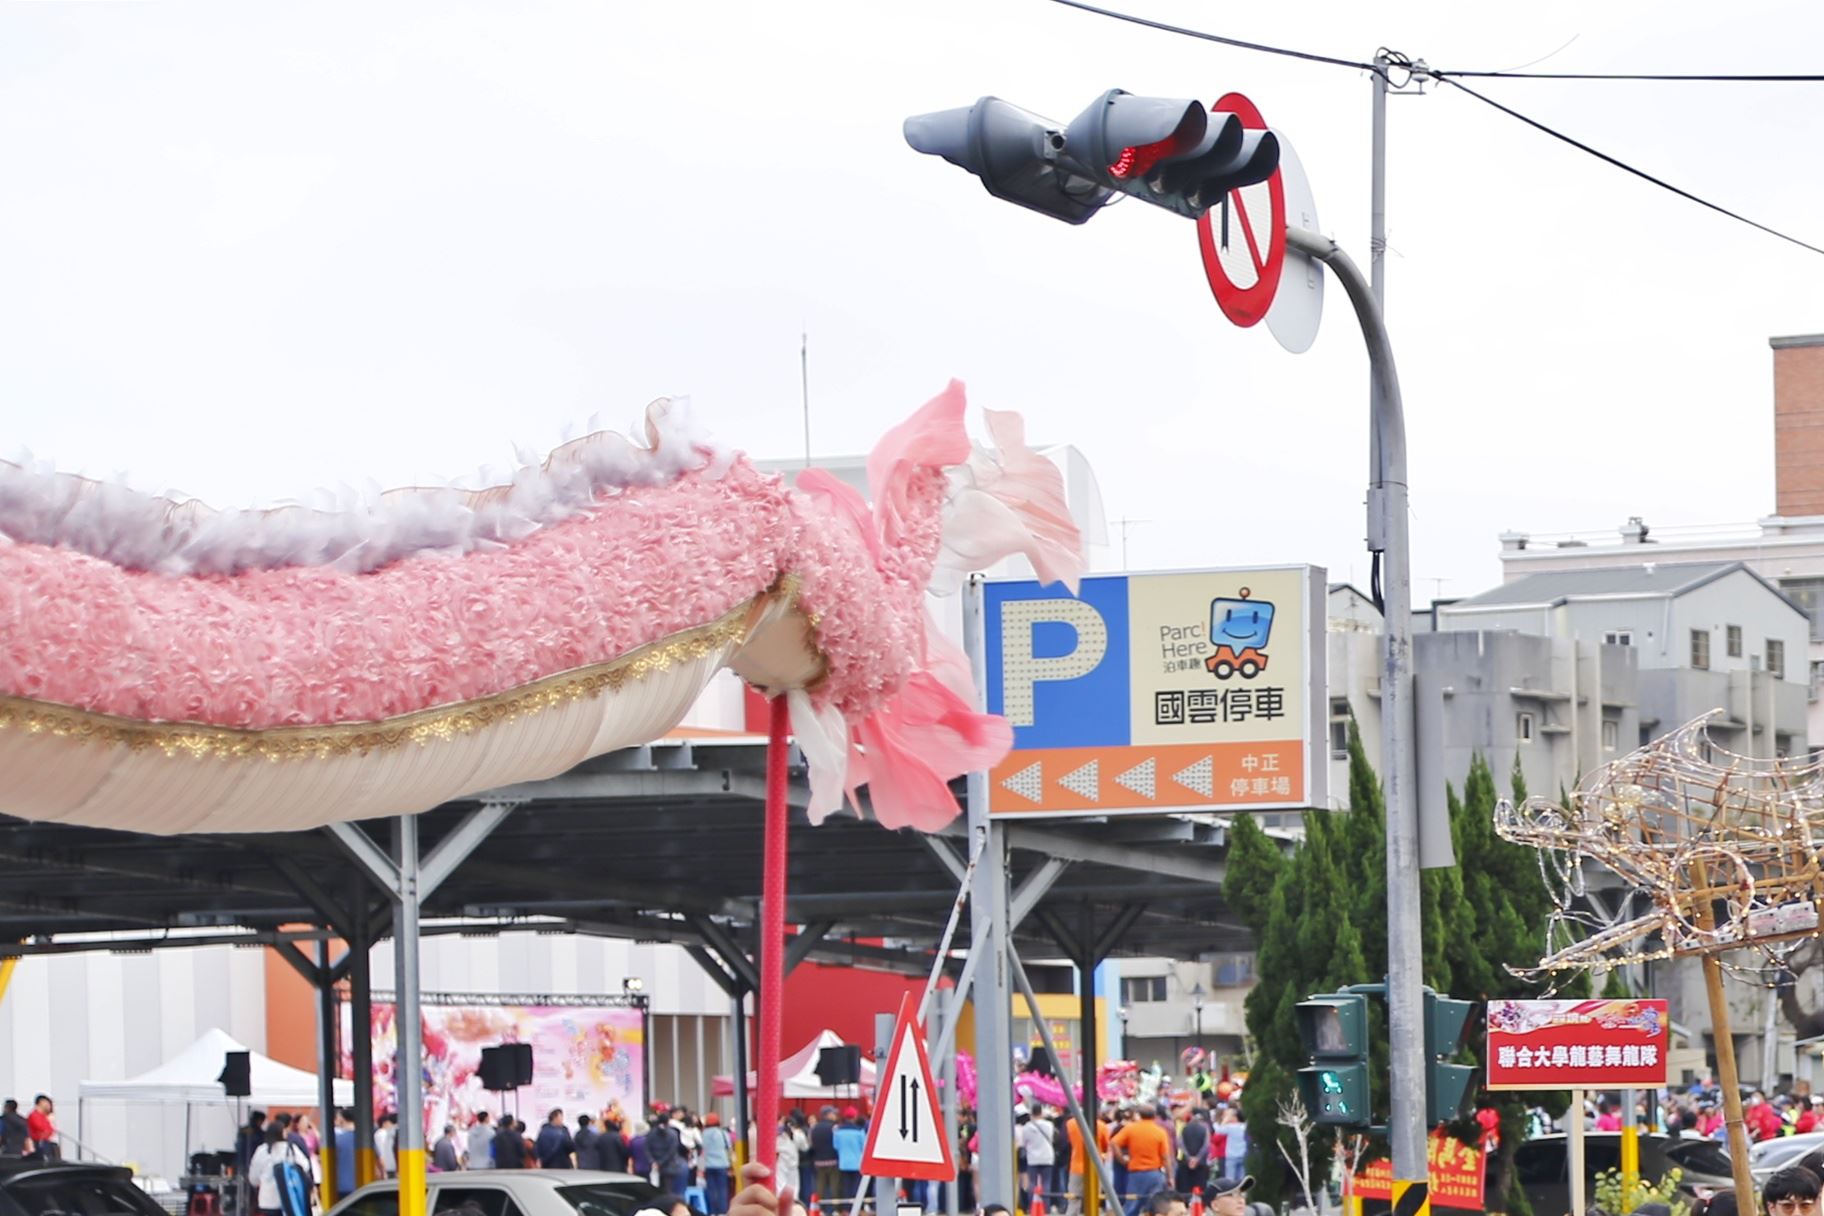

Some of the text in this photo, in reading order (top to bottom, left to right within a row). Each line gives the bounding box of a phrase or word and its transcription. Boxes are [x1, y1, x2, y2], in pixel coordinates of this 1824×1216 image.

[1161, 641, 1207, 660] Here
[1001, 598, 1108, 727] P
[1155, 686, 1285, 725] 國雲停車
[1241, 753, 1280, 773] 中正
[1230, 776, 1291, 797] 停車場
